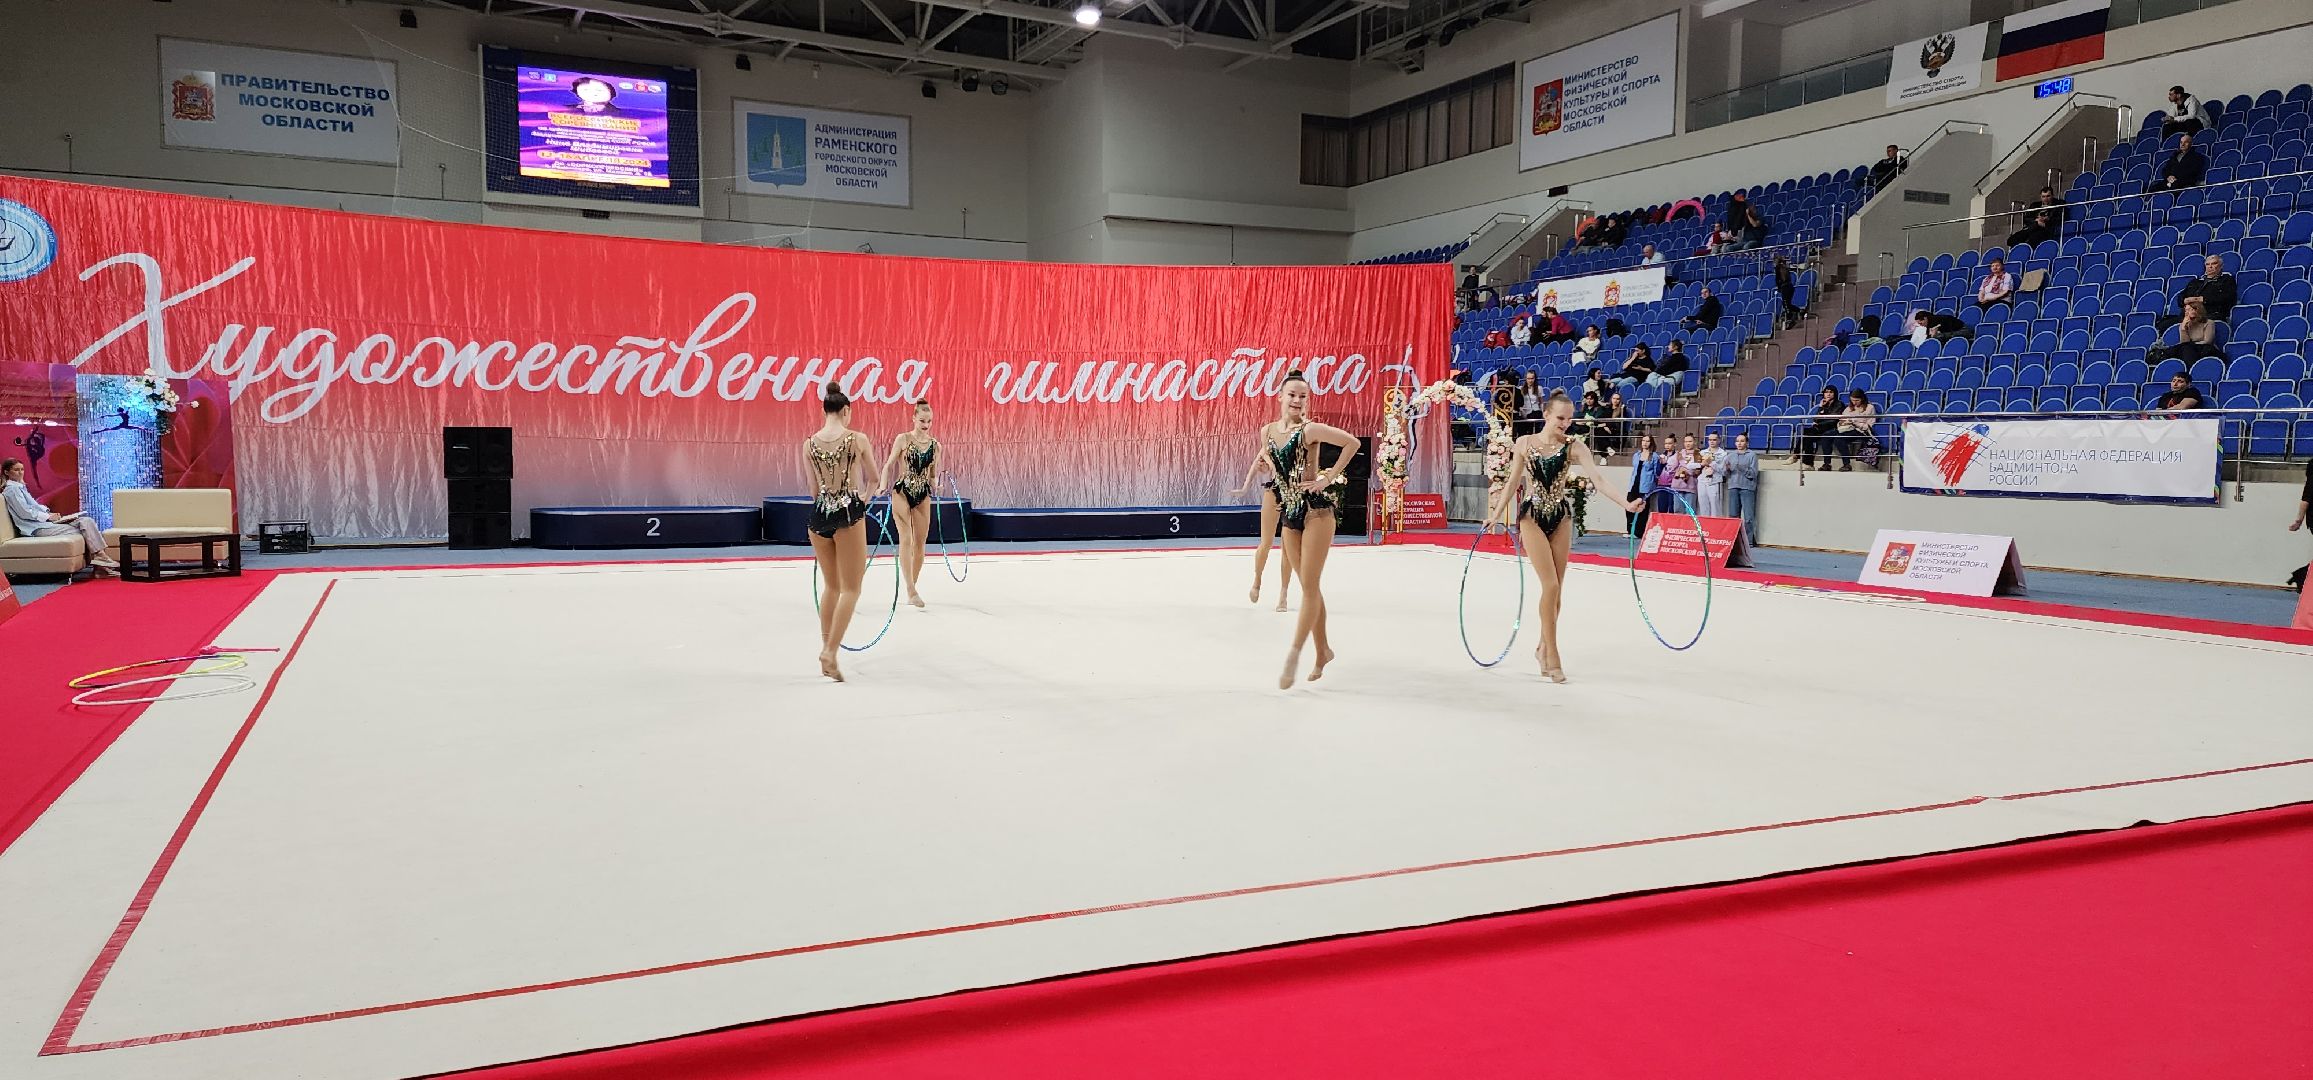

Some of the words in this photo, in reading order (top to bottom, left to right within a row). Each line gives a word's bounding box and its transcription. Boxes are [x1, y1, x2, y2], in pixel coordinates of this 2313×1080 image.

[1564, 55, 1639, 85] МИНИСТЕРСТВО
[221, 73, 390, 101] ПРАВИТЕЛЬСТВО
[1563, 70, 1628, 97] ФИЗИЧЕСКОЙ
[1563, 90, 1610, 110] КУЛЬТУРЫ
[1612, 86, 1620, 96] И
[1621, 74, 1661, 93] СПОРТА
[2040, 78, 2071, 98] 15:48
[238, 93, 375, 117] МОСКОВСКОЙ
[1563, 96, 1628, 121] МОСКОВСКОЙ
[262, 114, 354, 133] ОБЛАСТИ
[814, 123, 897, 140] АДМИНИСТРАЦИЯ
[1563, 115, 1605, 133] ОБЛАСТИ
[814, 137, 897, 155] РАМЕНСКОГО
[814, 152, 867, 165] ГОРОДСКОГО
[868, 156, 898, 168] ОКРУГА
[825, 164, 888, 178] МОСКОВСКОЙ
[835, 177, 878, 189] ОБЛАСТИ
[70, 253, 933, 424] Художественная
[984, 347, 1372, 405] гимнастика
[1989, 449, 2096, 461] НАЦИОНАЛЬНАЯ
[2099, 449, 2182, 464] ФЕДЕРАЦИЯ
[1989, 462, 2079, 474] БАДМИНТОНА
[1989, 474, 2038, 486] РОССИИ
[646, 517, 661, 537] 2
[875, 509, 884, 528] 1
[1168, 515, 1180, 534] 3
[1959, 560, 1989, 569] СПОРТА
